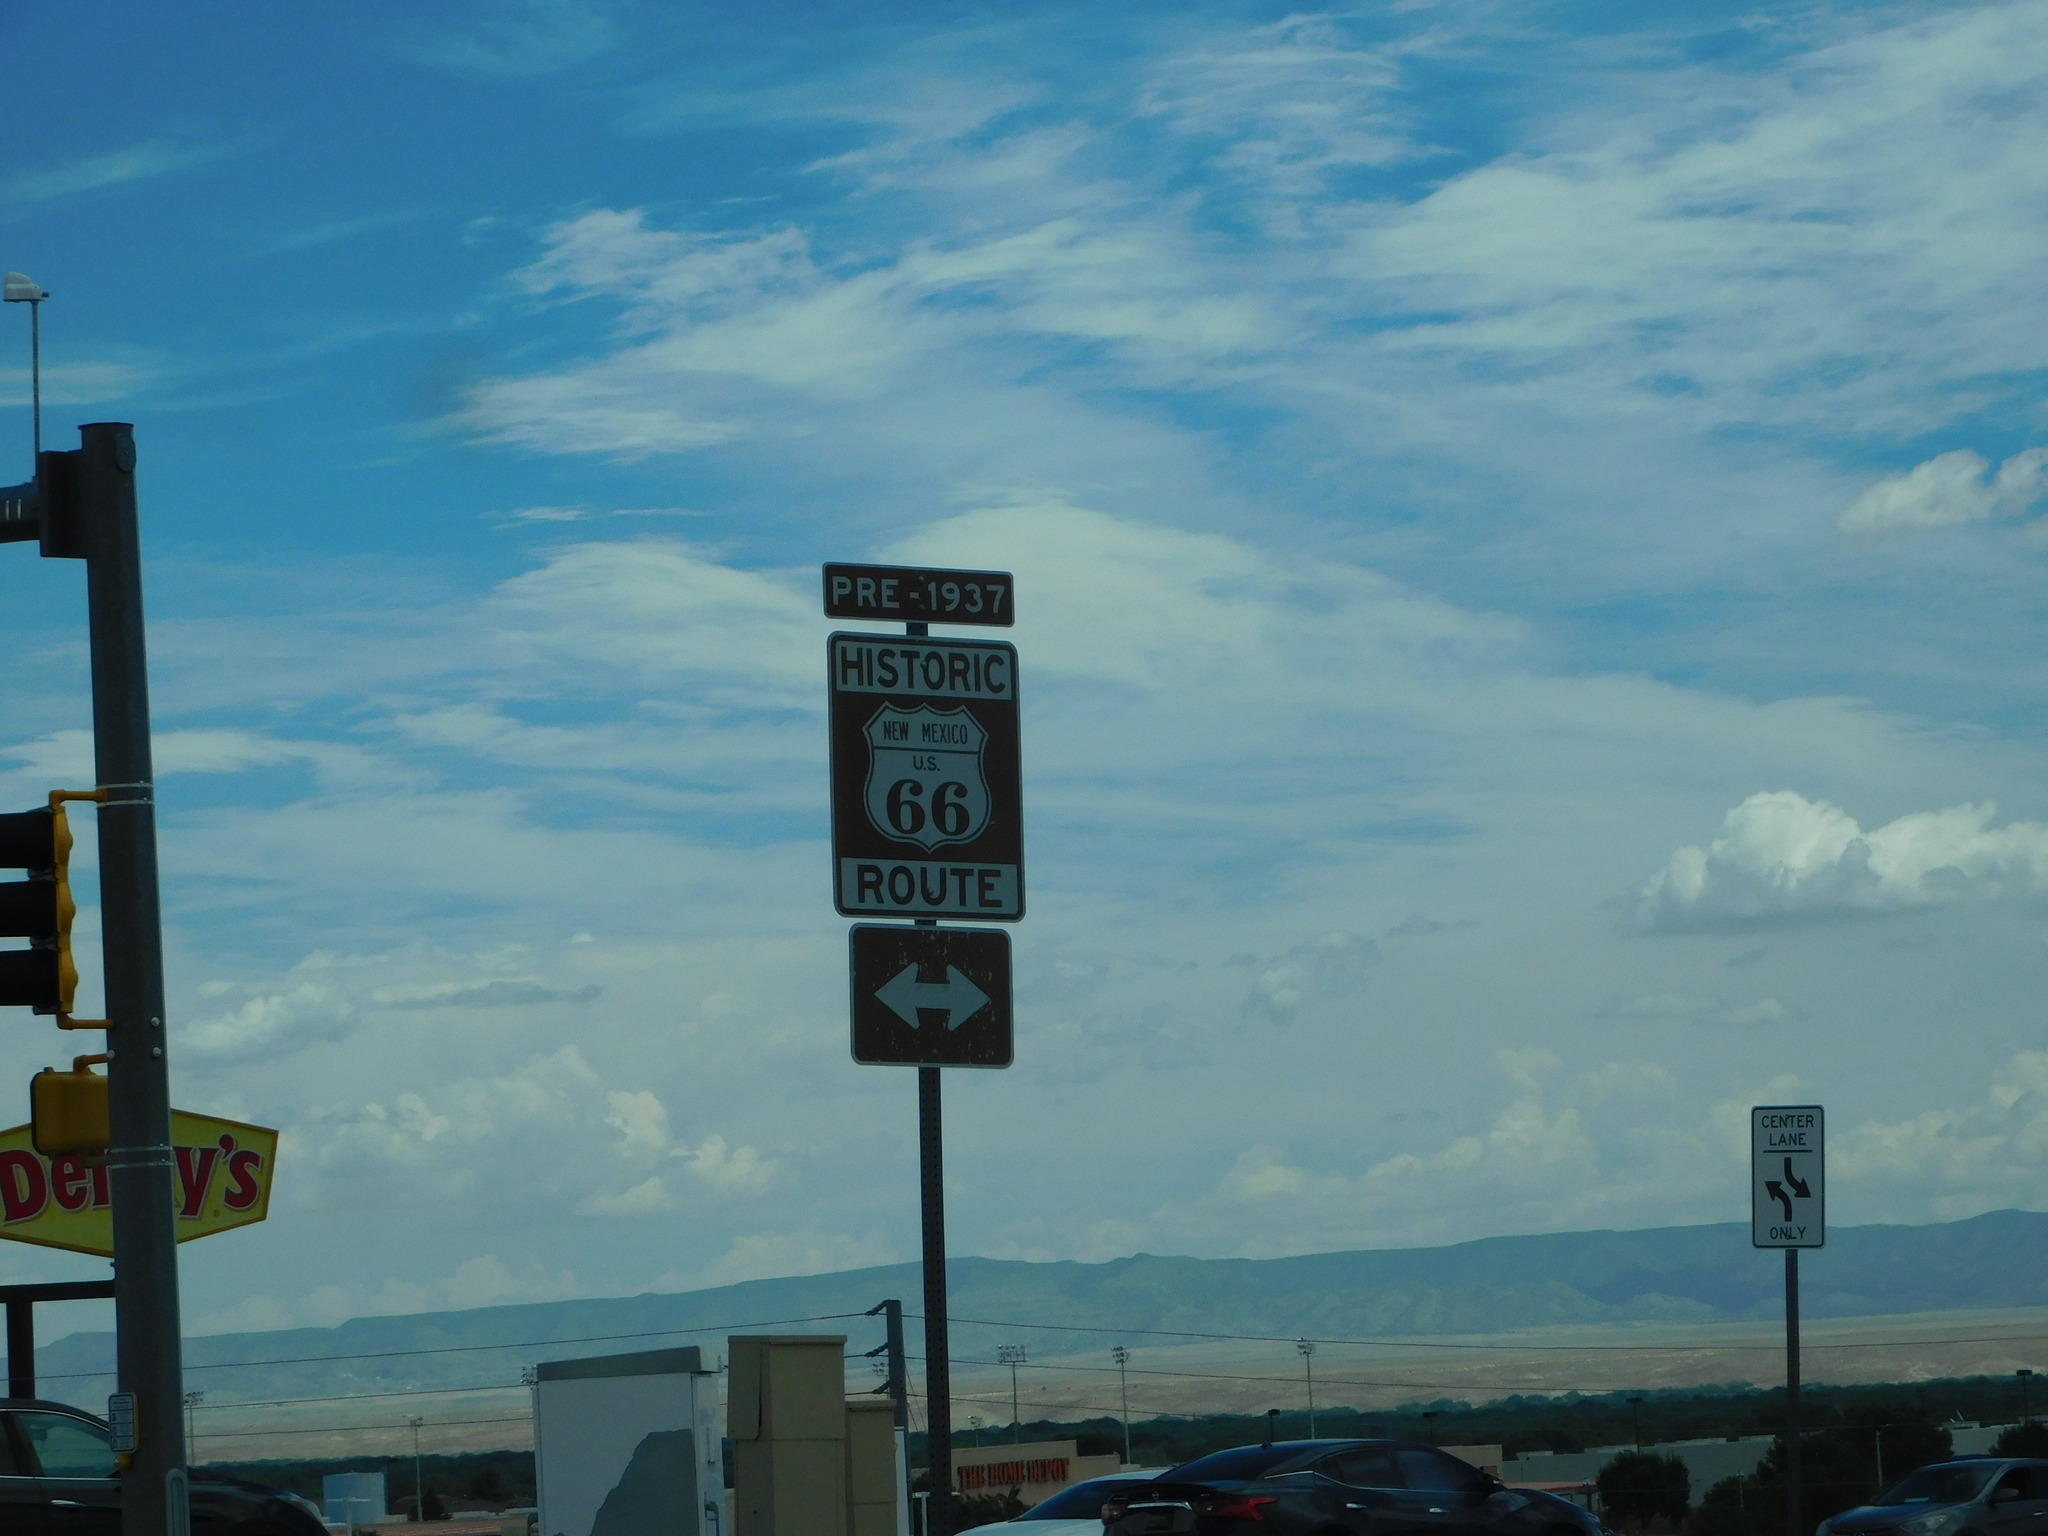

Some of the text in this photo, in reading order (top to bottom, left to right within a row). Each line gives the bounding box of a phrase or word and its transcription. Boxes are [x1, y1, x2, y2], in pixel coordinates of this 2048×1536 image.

[840, 646, 1006, 694] HISTORIC
[883, 720, 968, 745] NEW MEXICO
[913, 755, 940, 772] U.S.
[886, 778, 970, 837] 66
[857, 864, 1003, 908] ROUTE
[1761, 1114, 1815, 1129] CENTER
[1769, 1132, 1807, 1147] LANE
[0, 1133, 262, 1225] Dey's
[1769, 1226, 1807, 1240] ONLY
